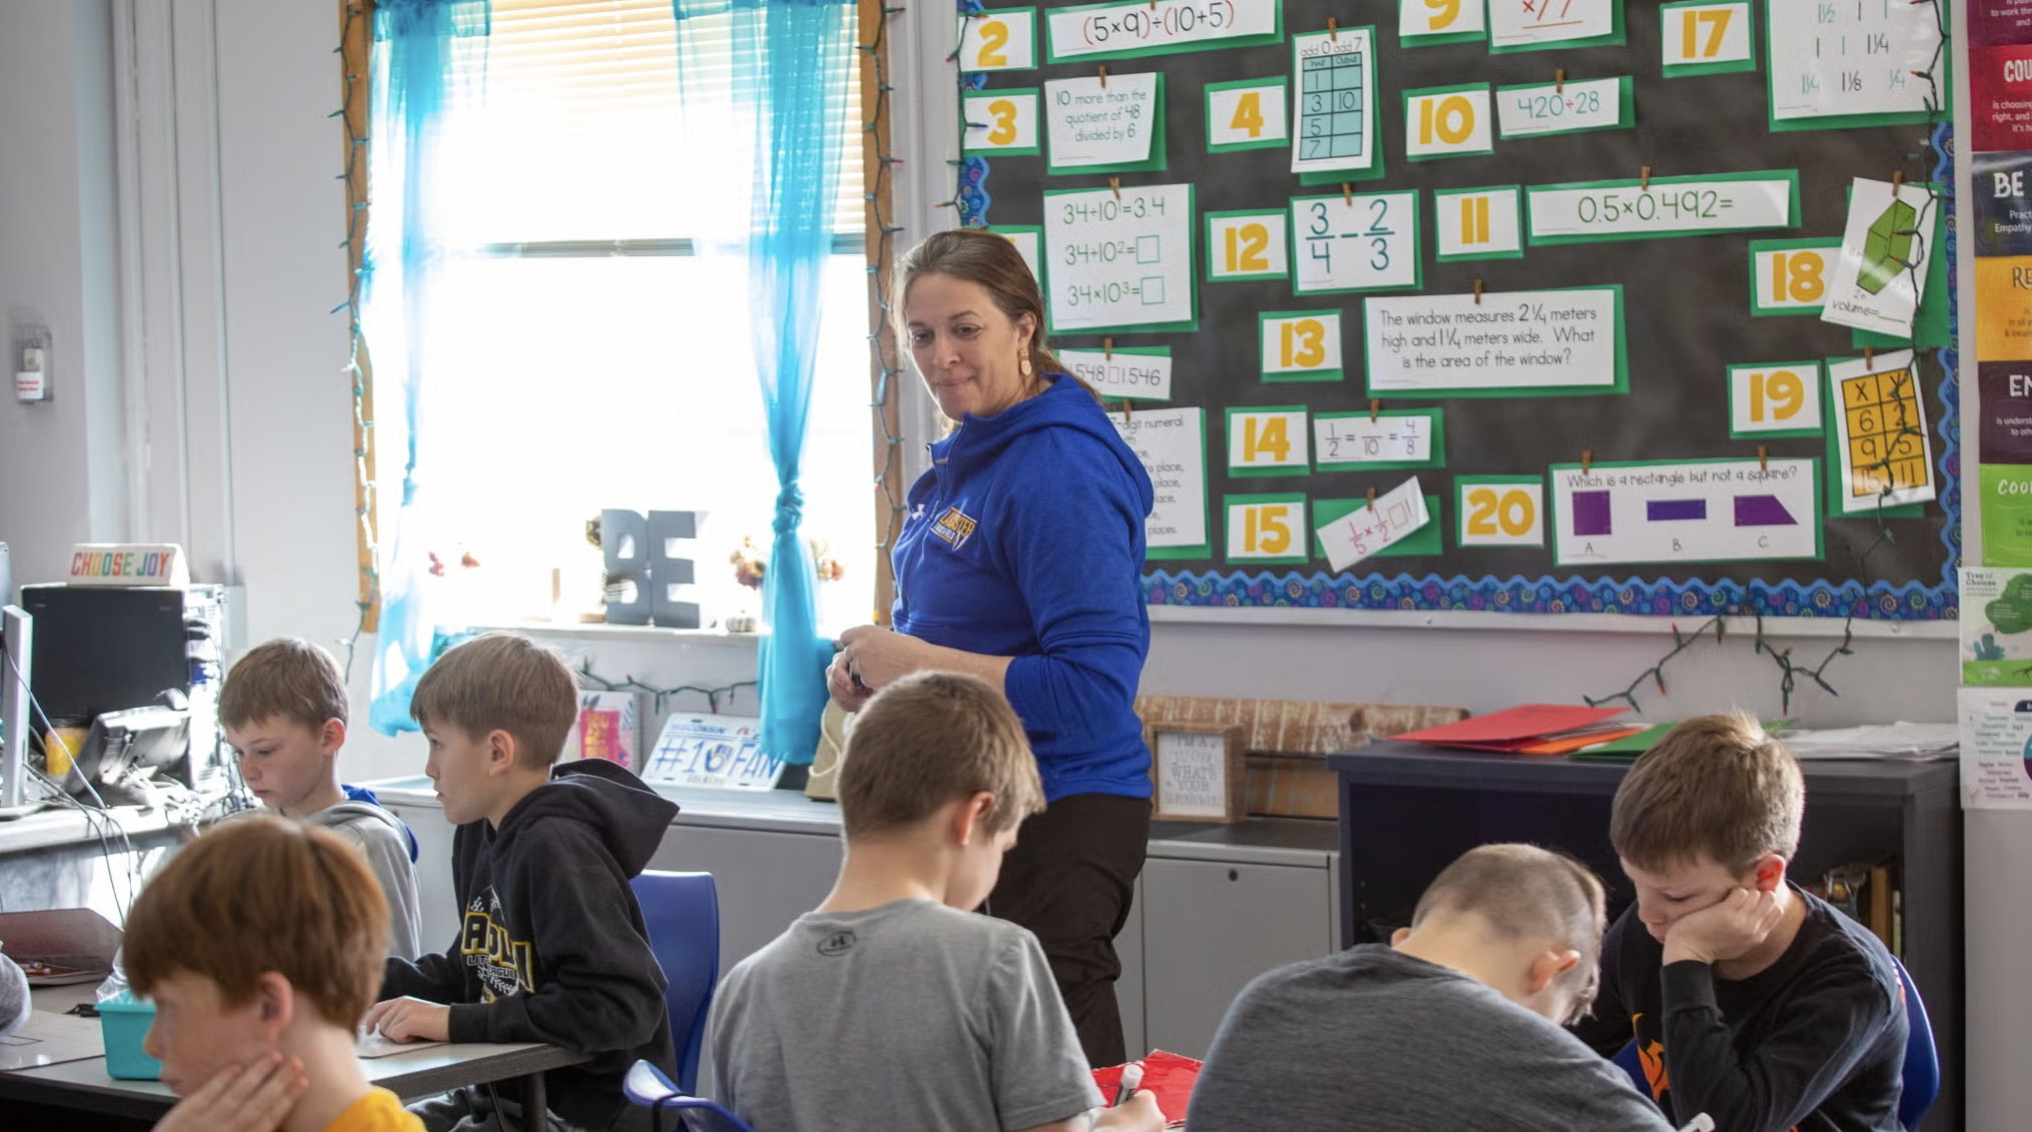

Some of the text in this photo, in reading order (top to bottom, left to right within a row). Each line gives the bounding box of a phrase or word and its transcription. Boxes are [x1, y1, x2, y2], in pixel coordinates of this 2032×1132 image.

[1425, 0, 1461, 31] 9
[977, 21, 1009, 67] 2
[1301, 43, 1319, 57] add
[1333, 39, 1352, 53] add
[1354, 37, 1362, 51] 7
[1681, 9, 1734, 59] 17
[1056, 88, 1147, 106] 10 more than the
[1311, 91, 1355, 113] 3 10
[988, 99, 1018, 146] 3
[1065, 104, 1140, 128] quotient of 48
[1229, 93, 1264, 137] 4
[1310, 118, 1322, 136] 5
[1419, 95, 1475, 145] 10
[1075, 123, 1136, 141] divided by 6
[1310, 139, 1321, 158] 7
[1993, 170, 2024, 198] BE
[1461, 196, 1490, 244] 11
[1225, 223, 1269, 272] 12
[1772, 251, 1825, 302] 18
[1380, 309, 1403, 326] The
[1407, 308, 1451, 325] window
[1455, 312, 1515, 324] measures
[1550, 307, 1597, 320] meters
[1281, 318, 1325, 368] 13
[1381, 330, 1407, 353] high
[1411, 330, 1436, 346] and
[1464, 332, 1509, 345] meters
[1512, 327, 1543, 344] wide.
[1553, 326, 1595, 342] What
[1402, 347, 1572, 369] is the area of the window?
[1750, 370, 1804, 422] 19
[1855, 382, 1869, 401] X
[1145, 414, 1183, 428] numeral
[1859, 410, 1874, 432] 6
[1243, 417, 1290, 462] 14
[1861, 437, 1877, 460] 9
[1156, 461, 1184, 474] place,
[1567, 465, 1798, 488] Which is a rectangle but not a square?
[1901, 462, 1915, 485] 11
[1467, 488, 1535, 537] 20
[1244, 506, 1291, 555] 15
[71, 552, 169, 577] CHOOSE JOY
[601, 508, 701, 629] BE
